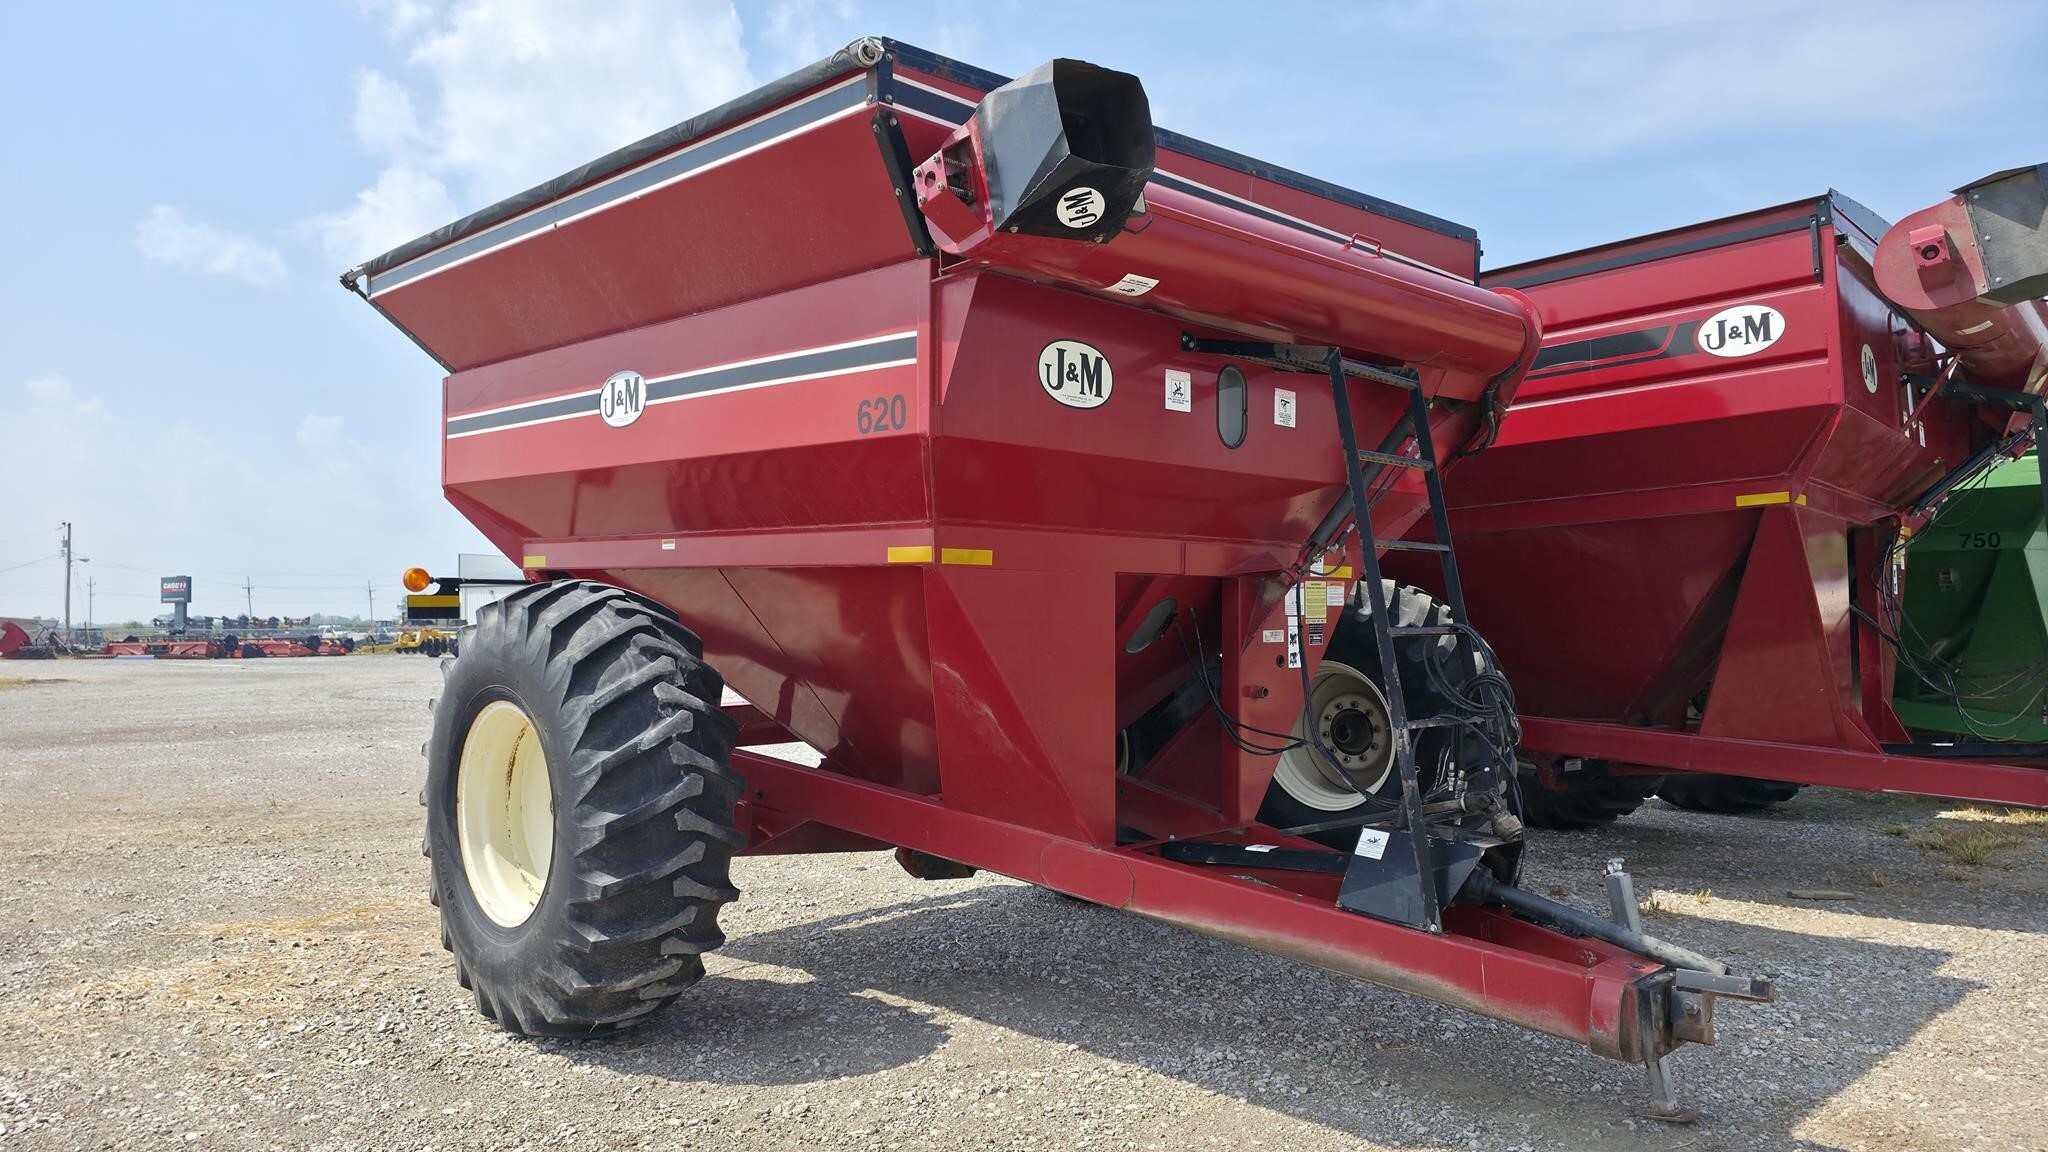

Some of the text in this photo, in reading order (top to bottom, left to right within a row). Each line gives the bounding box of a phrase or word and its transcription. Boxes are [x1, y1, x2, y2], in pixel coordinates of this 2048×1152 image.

[1063, 190, 1098, 226] J&M
[1704, 312, 1772, 350] J&M
[1044, 347, 1104, 398] J&M
[603, 376, 640, 418] J&M
[857, 394, 906, 434] 620
[1958, 532, 2001, 549] 750
